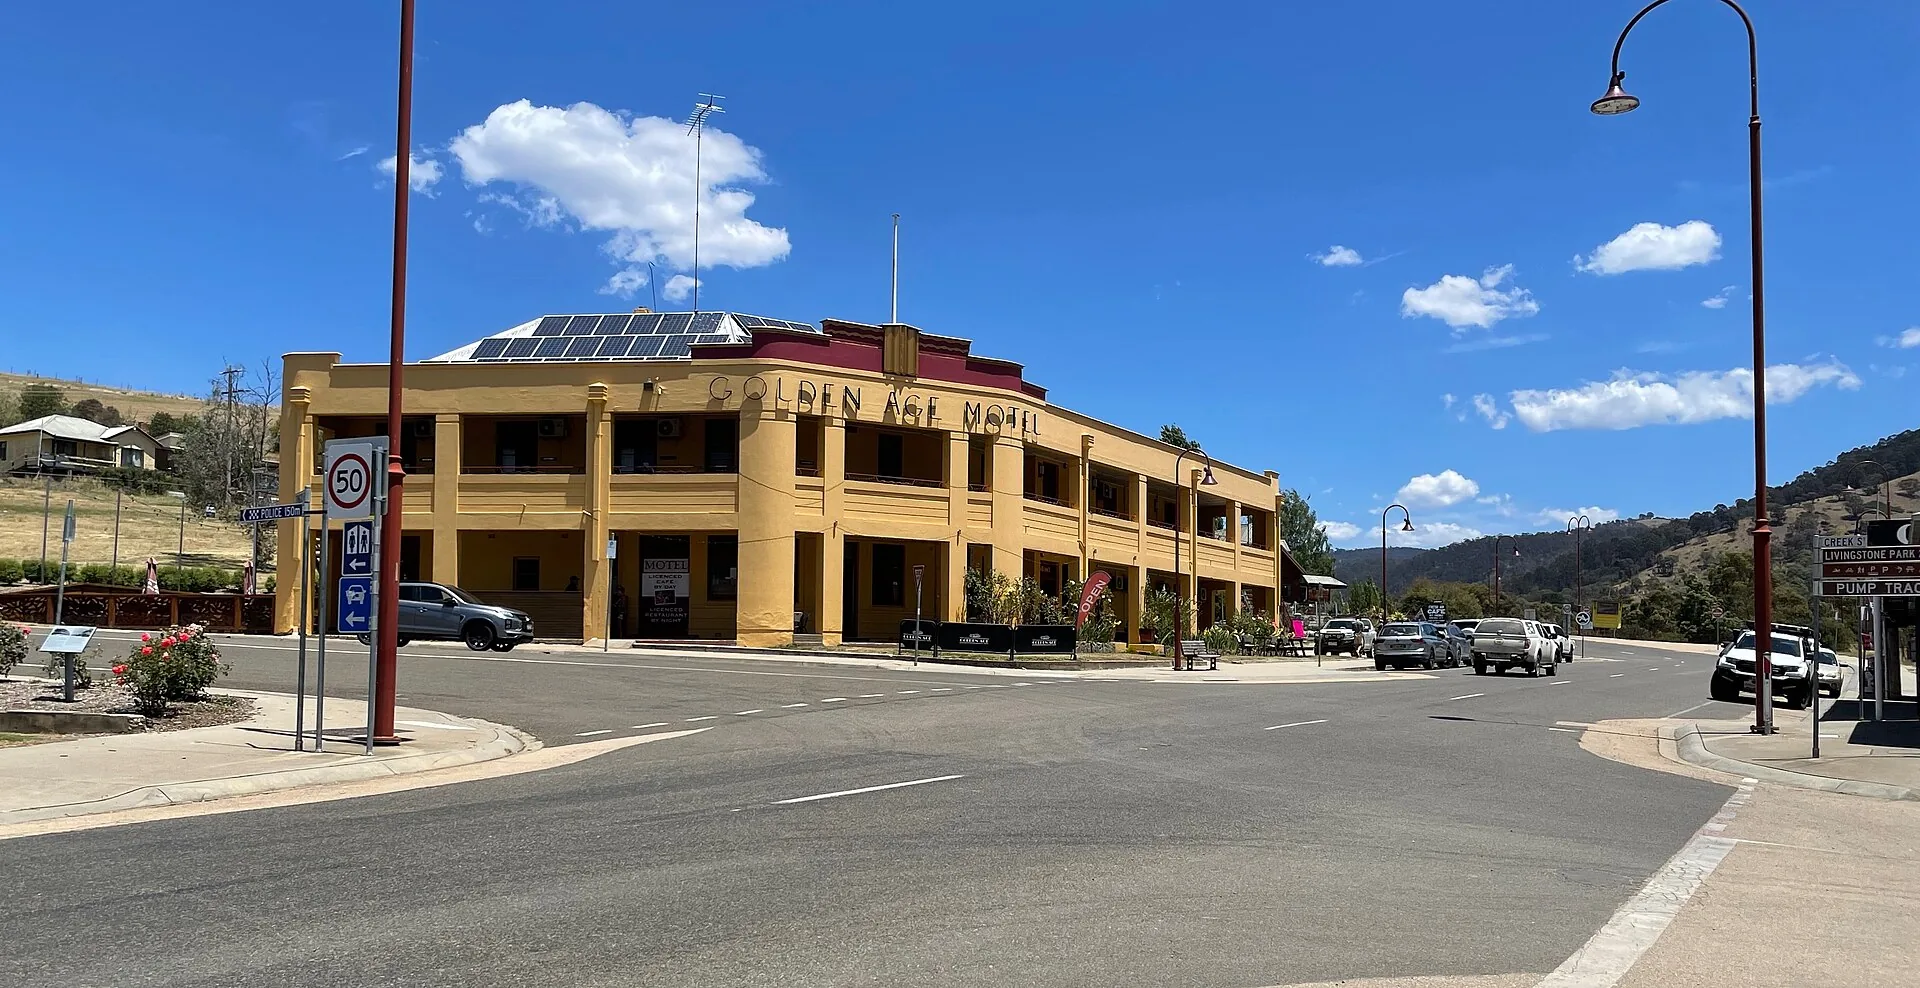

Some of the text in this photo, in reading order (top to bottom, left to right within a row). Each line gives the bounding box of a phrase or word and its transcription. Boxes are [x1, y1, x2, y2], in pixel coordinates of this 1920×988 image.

[709, 376, 1042, 436] GOLDEN AGE MOTEL
[336, 468, 363, 494] 50
[260, 505, 300, 519] POLICE 150m
[1824, 537, 1853, 547] CREEK
[1825, 550, 1887, 560] LIVINGSTONE
[1889, 549, 1915, 559] PARK
[645, 560, 688, 570] MOTEL
[1836, 582, 1877, 594] PUMP
[1081, 579, 1107, 613] OPEN
